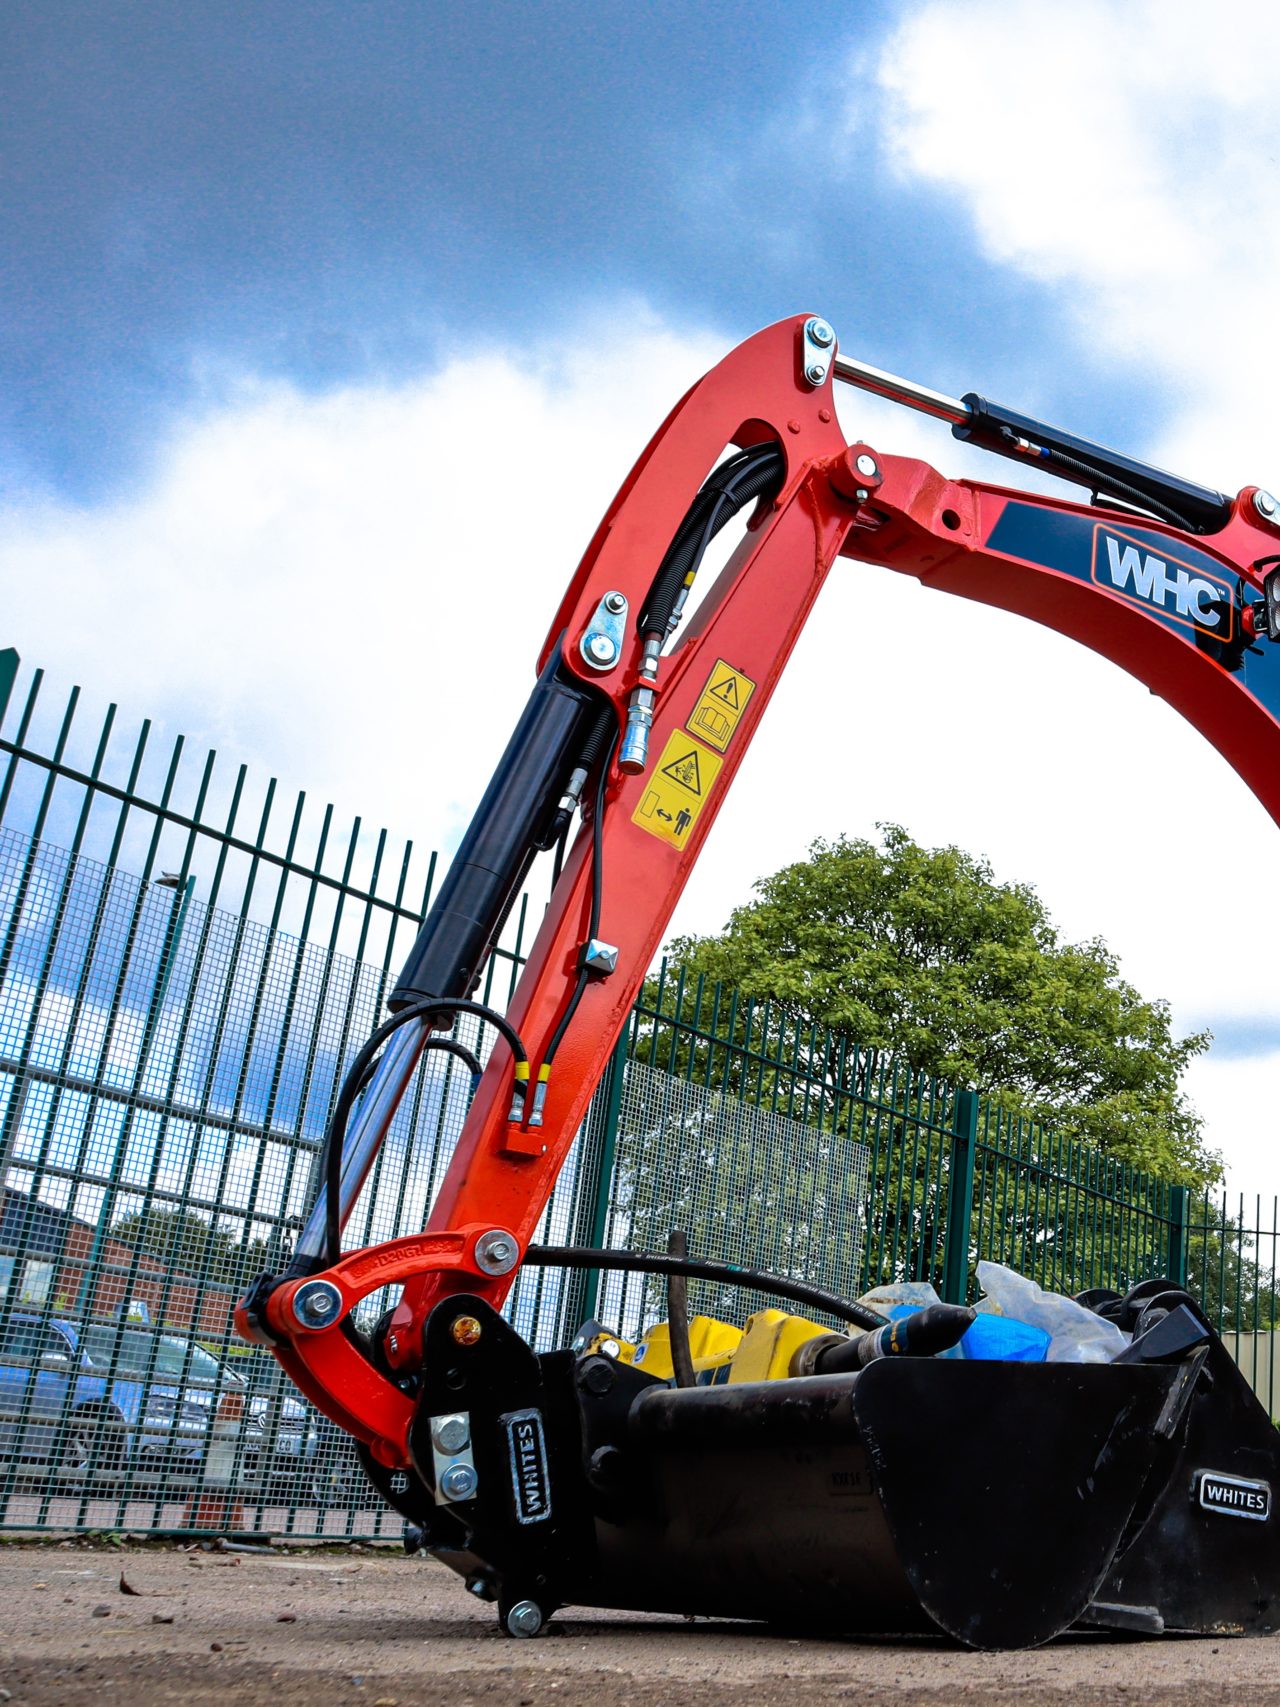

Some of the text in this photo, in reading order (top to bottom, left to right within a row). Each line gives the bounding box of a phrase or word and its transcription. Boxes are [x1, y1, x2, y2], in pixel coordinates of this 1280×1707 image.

[1106, 535, 1221, 626] WHC
[518, 1424, 542, 1513] WHITES
[1207, 1485, 1265, 1509] WHITES
